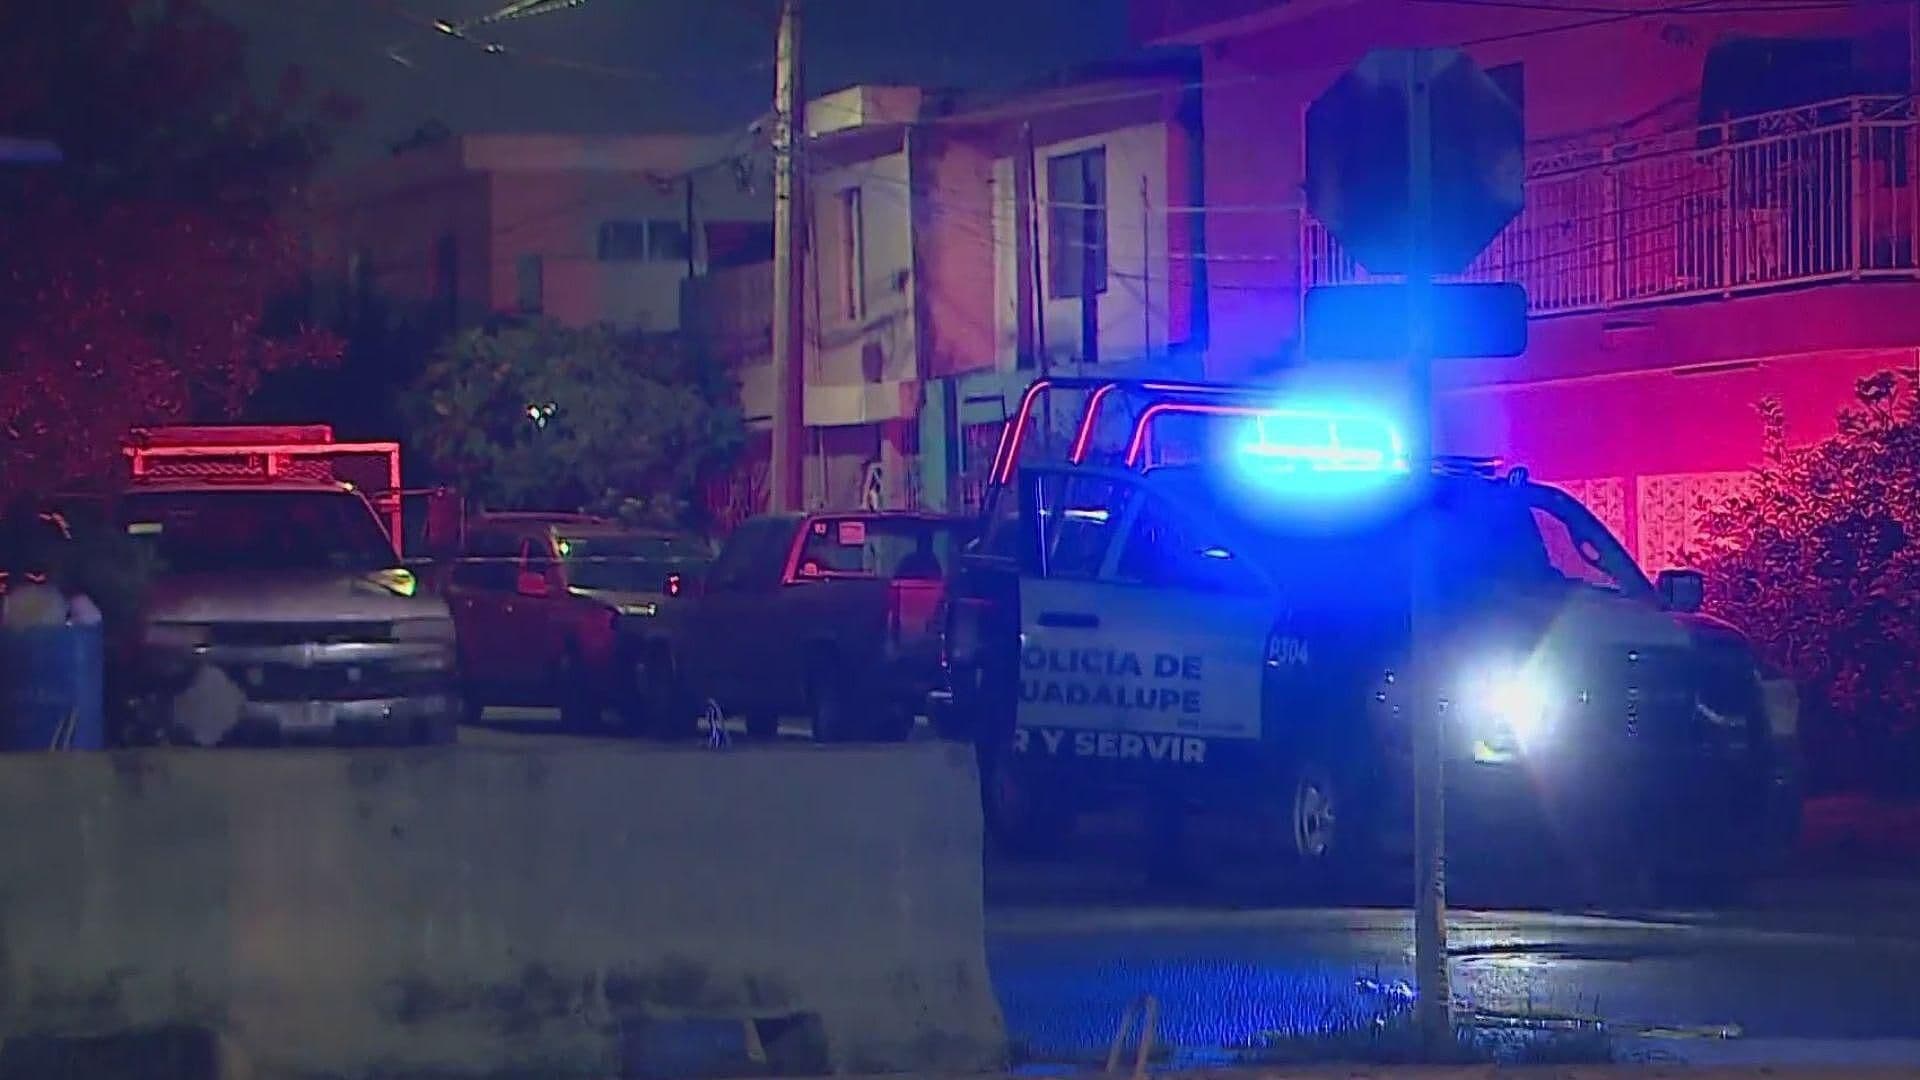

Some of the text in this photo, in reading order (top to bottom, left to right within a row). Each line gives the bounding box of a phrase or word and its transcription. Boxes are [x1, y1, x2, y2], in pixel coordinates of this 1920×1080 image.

[1153, 653, 1202, 681] DE
[1017, 680, 1202, 714] UADALUPE
[1040, 729, 1065, 755] Y
[1074, 732, 1208, 764] SERVIR
